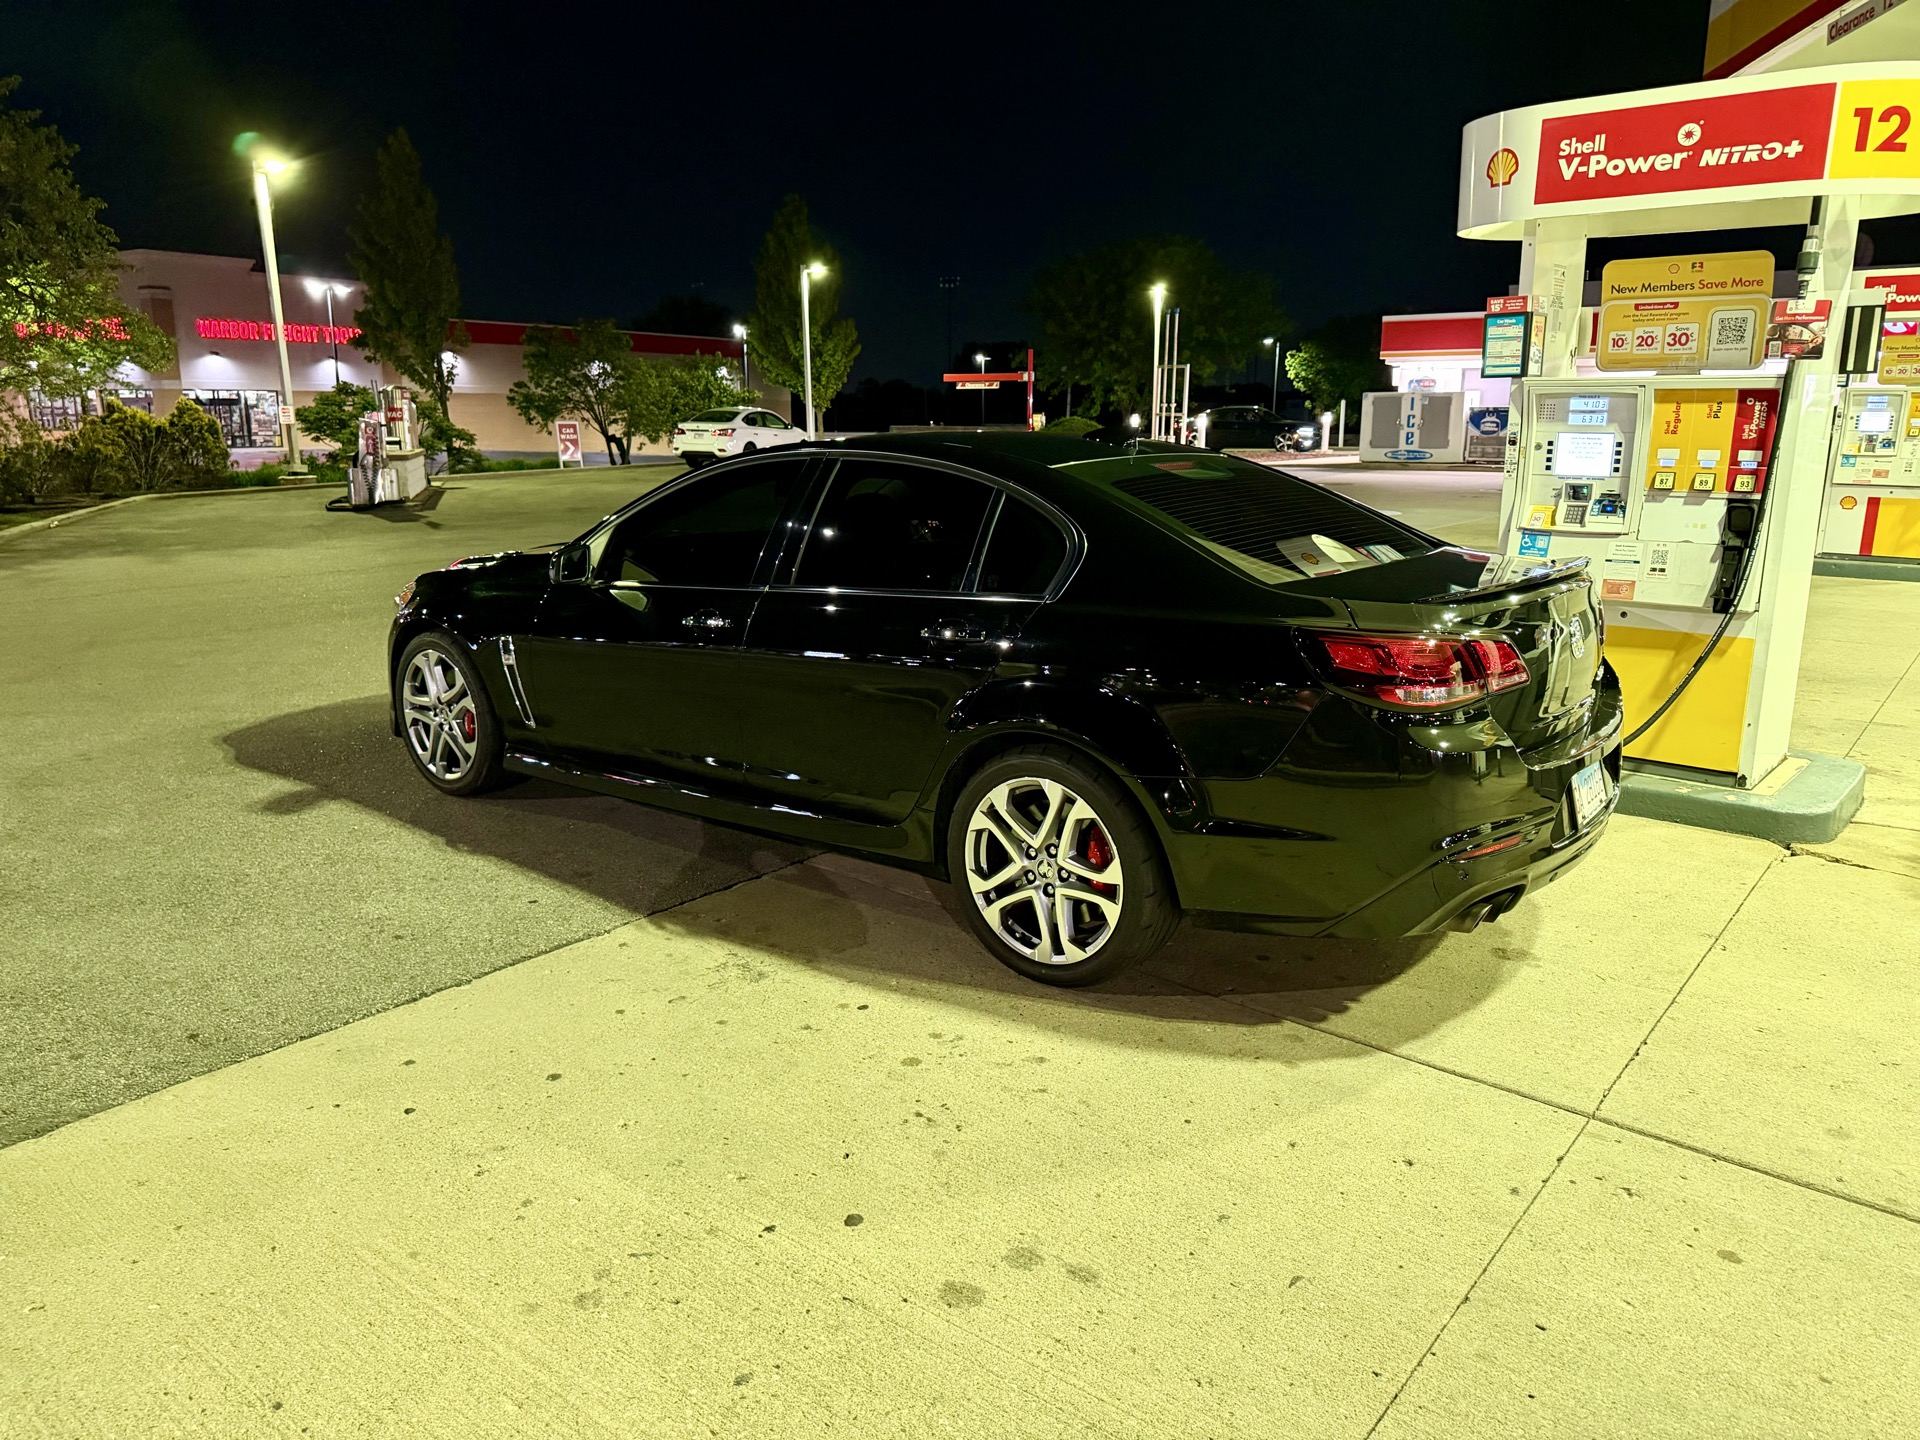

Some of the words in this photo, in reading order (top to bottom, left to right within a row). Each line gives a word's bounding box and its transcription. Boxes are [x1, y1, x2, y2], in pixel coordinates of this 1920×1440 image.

[1829, 6, 1876, 41] Clearance
[1853, 105, 1911, 152] 12
[1558, 134, 1606, 157] Shell
[1557, 151, 1688, 181] V-Power
[1610, 284, 1638, 294] New
[1640, 280, 1695, 293] Members
[1698, 279, 1728, 289] Save
[1731, 277, 1764, 288] More
[196, 319, 259, 340] HARBOR
[323, 325, 362, 344] TOO
[1670, 400, 1682, 435] Regular
[1713, 400, 1723, 419] Plus
[1748, 400, 1762, 440] V-Power
[1742, 424, 1750, 440] Shell
[1658, 478, 1669, 486] 87
[1698, 479, 1709, 487] 89
[1740, 480, 1750, 488] 93
